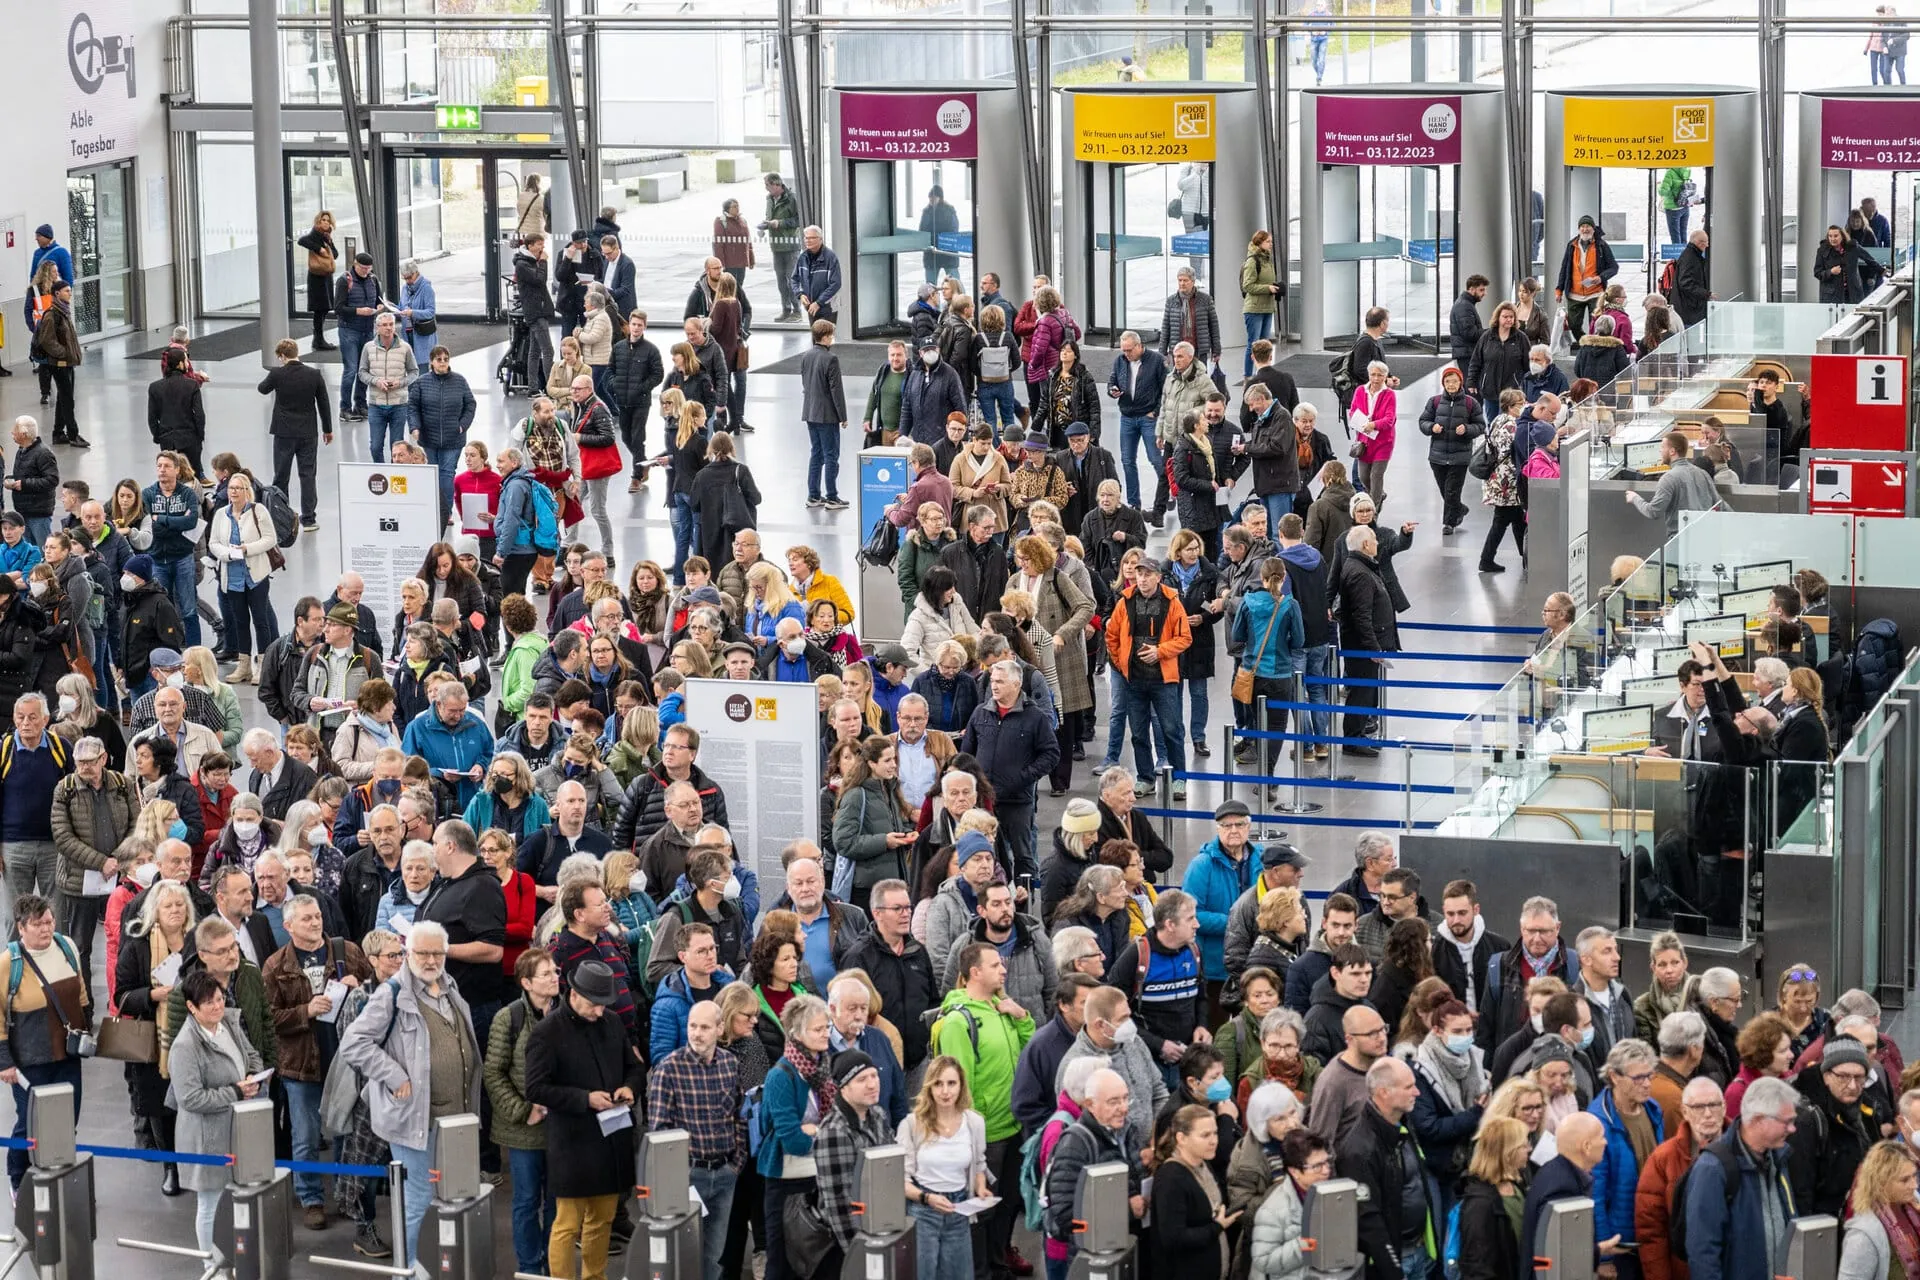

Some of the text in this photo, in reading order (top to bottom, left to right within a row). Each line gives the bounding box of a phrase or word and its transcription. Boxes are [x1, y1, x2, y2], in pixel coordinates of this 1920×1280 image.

[70, 109, 93, 129] Able
[859, 128, 880, 136] freuen
[897, 128, 911, 137] auf
[1338, 132, 1362, 141] freuen
[1588, 135, 1612, 143] freuen
[1832, 136, 1844, 144] Wir
[1846, 136, 1872, 145] freuen
[1892, 137, 1907, 145] auf
[71, 134, 116, 158] Tagesbar
[848, 140, 873, 152] 29.11.
[885, 142, 950, 153] 03.12.2023
[1083, 143, 1109, 154] 29.11.
[1122, 144, 1188, 155] 03.12.2023
[1325, 146, 1353, 157] 29.11.
[1367, 147, 1435, 158] 03.12.2023
[1574, 148, 1603, 159] 29.11.
[1617, 149, 1687, 160] 03.12.2023
[1832, 150, 1863, 162] 29.11.
